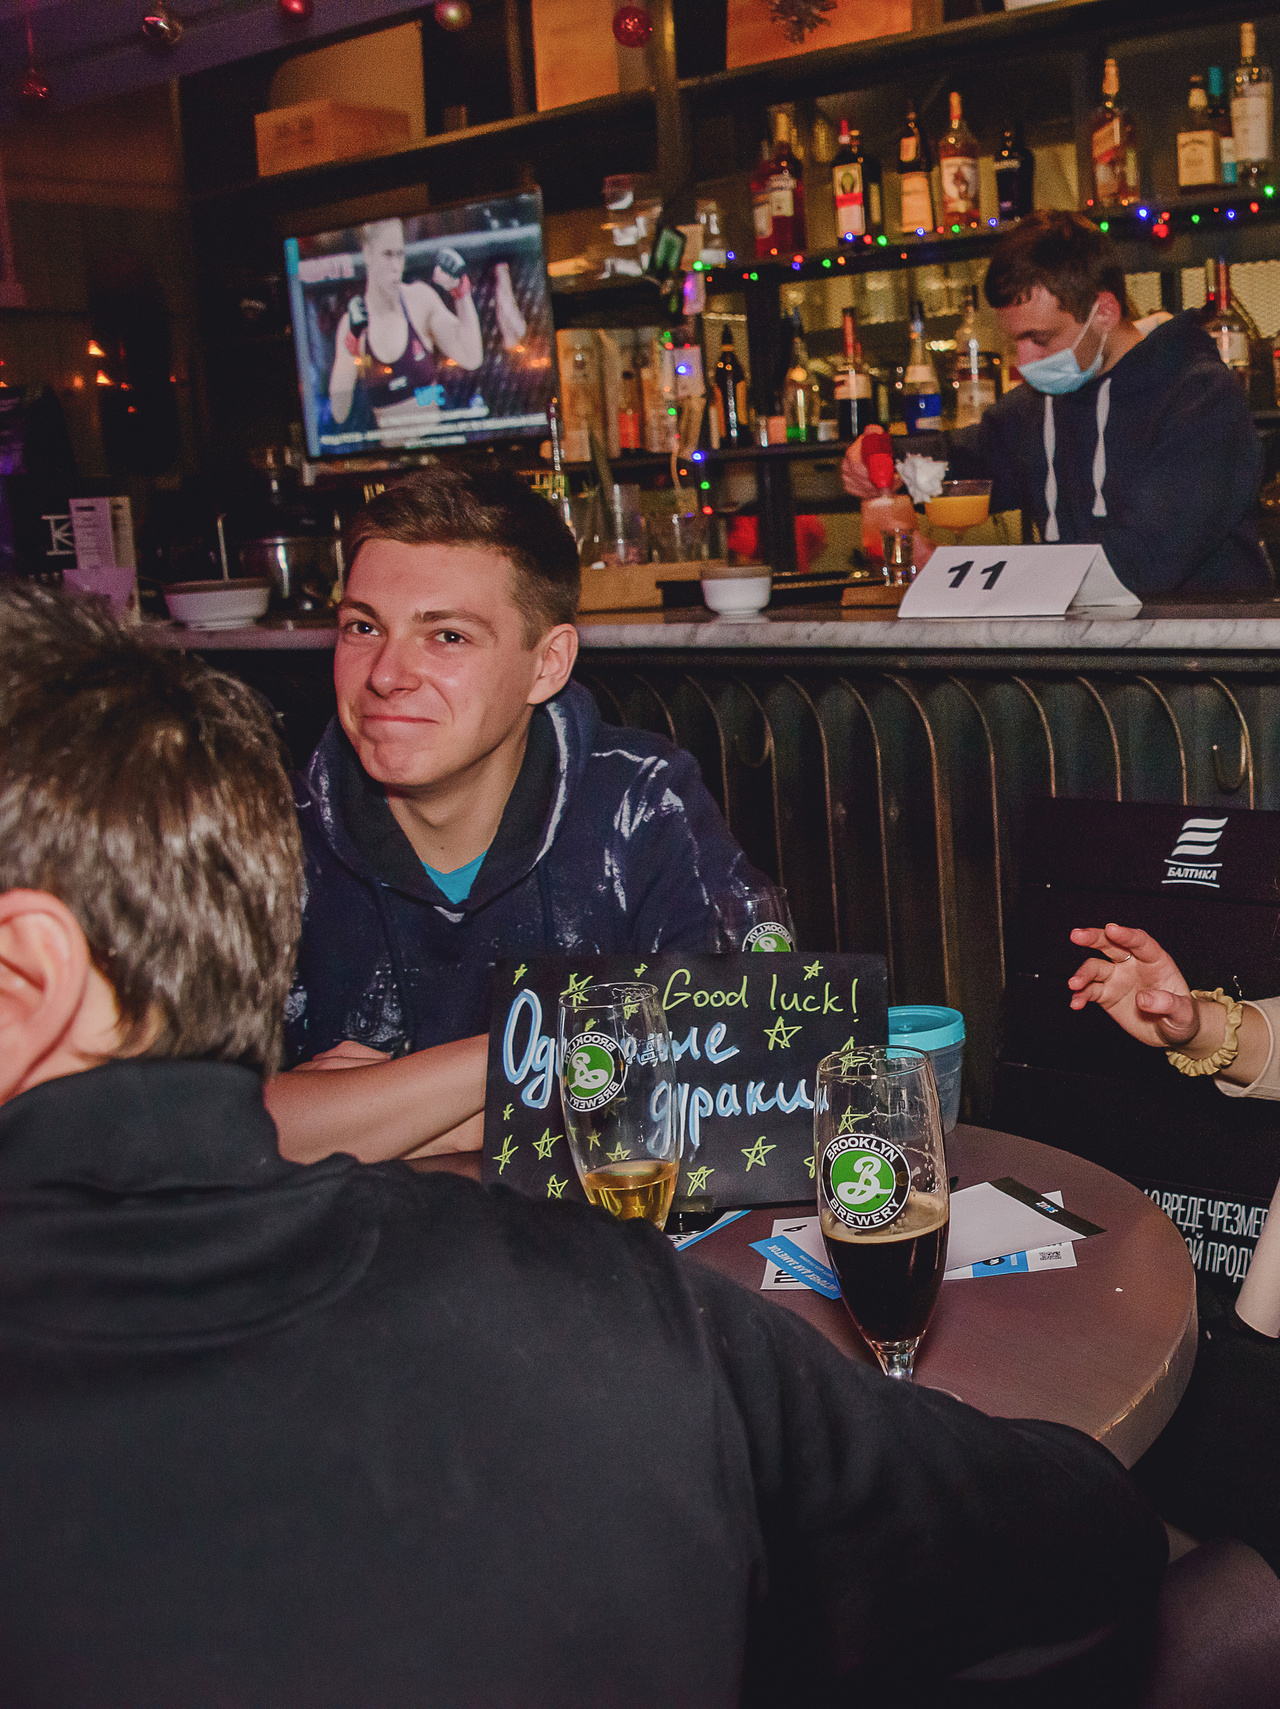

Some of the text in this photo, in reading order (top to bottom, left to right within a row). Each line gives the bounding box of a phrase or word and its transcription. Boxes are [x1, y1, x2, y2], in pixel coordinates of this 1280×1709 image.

[947, 560, 1008, 590] 11
[1166, 867, 1218, 880] БАЛТИКА
[663, 968, 859, 1022] Good luck!
[826, 1137, 899, 1163] BROOKLYN
[829, 1198, 900, 1226] BREWERY
[1205, 1242, 1253, 1283] ПРОД
